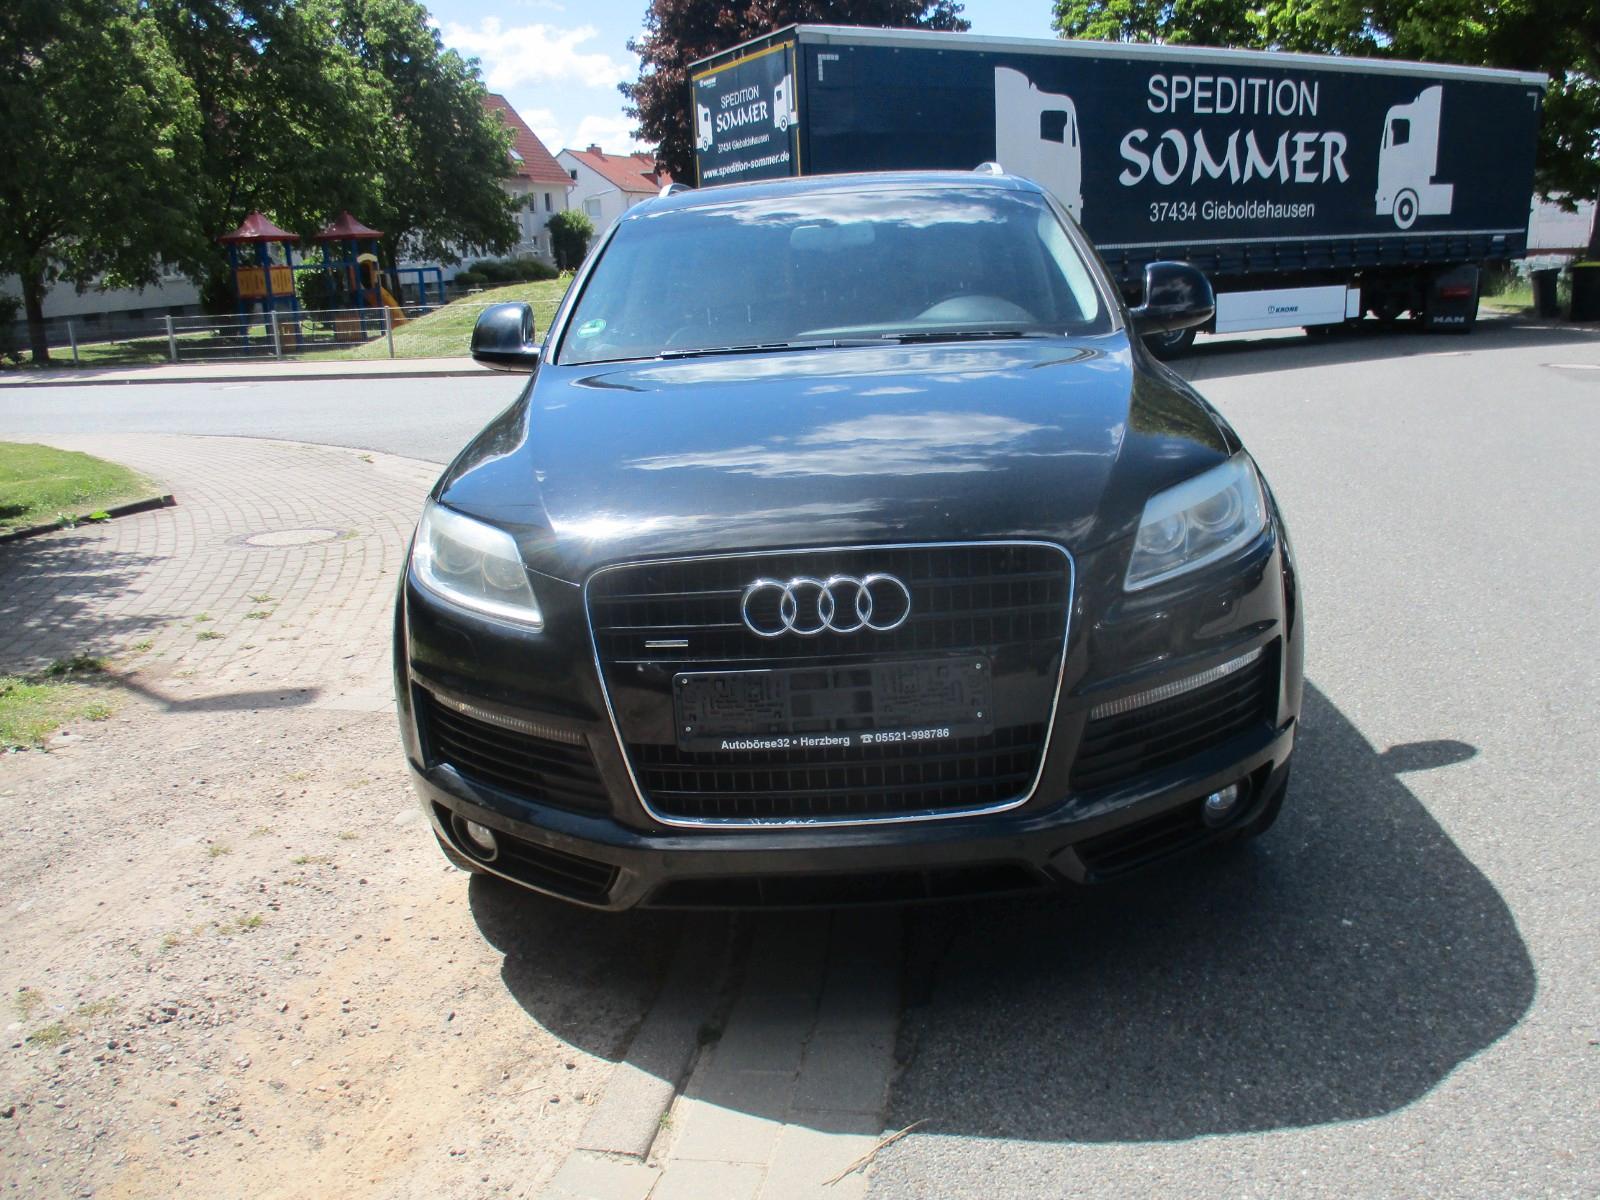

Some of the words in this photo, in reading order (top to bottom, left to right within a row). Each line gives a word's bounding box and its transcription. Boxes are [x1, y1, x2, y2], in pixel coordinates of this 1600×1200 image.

[720, 85, 759, 109] SPEDITION
[1147, 74, 1319, 116] SPEDITION
[716, 101, 769, 133] SOMMER
[717, 142, 732, 154] 37434
[731, 134, 770, 150] Gieboldehausen
[703, 150, 790, 179] www.spedition-sommer.de
[1118, 128, 1350, 187] SOMMER
[1149, 201, 1197, 223] 37434
[1201, 200, 1316, 220] Gieboldehausen
[1275, 305, 1299, 313] KRONE
[721, 738, 790, 750] Autobörse32
[800, 736, 850, 747] Herzberg
[875, 728, 950, 743] 05521-998786
